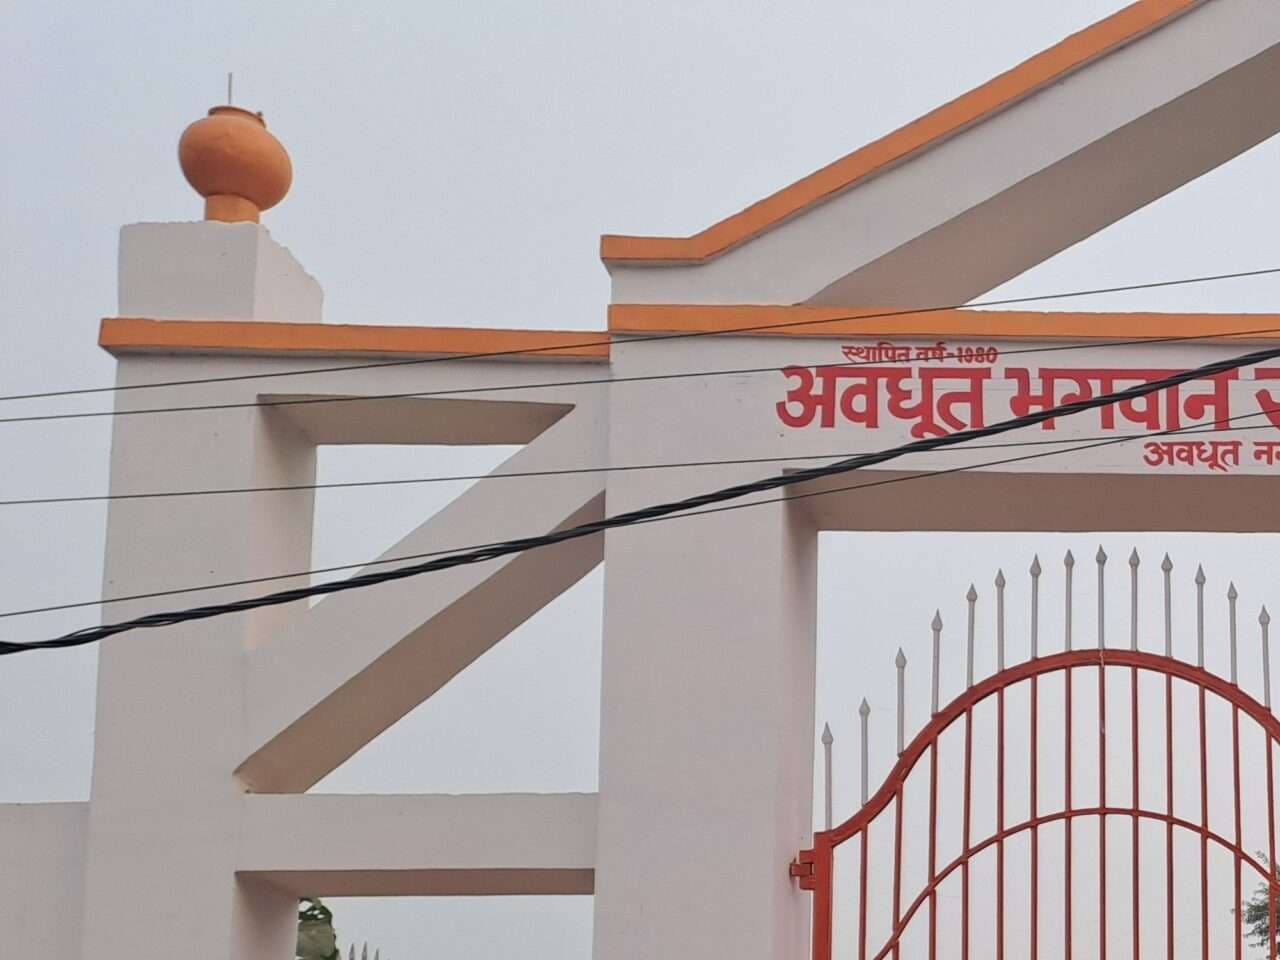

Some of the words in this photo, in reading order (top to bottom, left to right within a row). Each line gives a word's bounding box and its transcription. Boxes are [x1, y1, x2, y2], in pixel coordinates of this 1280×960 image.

[775, 366, 992, 438] अवधूत
[1004, 367, 1239, 432] भगवान
[1143, 440, 1243, 472] अवधूत
